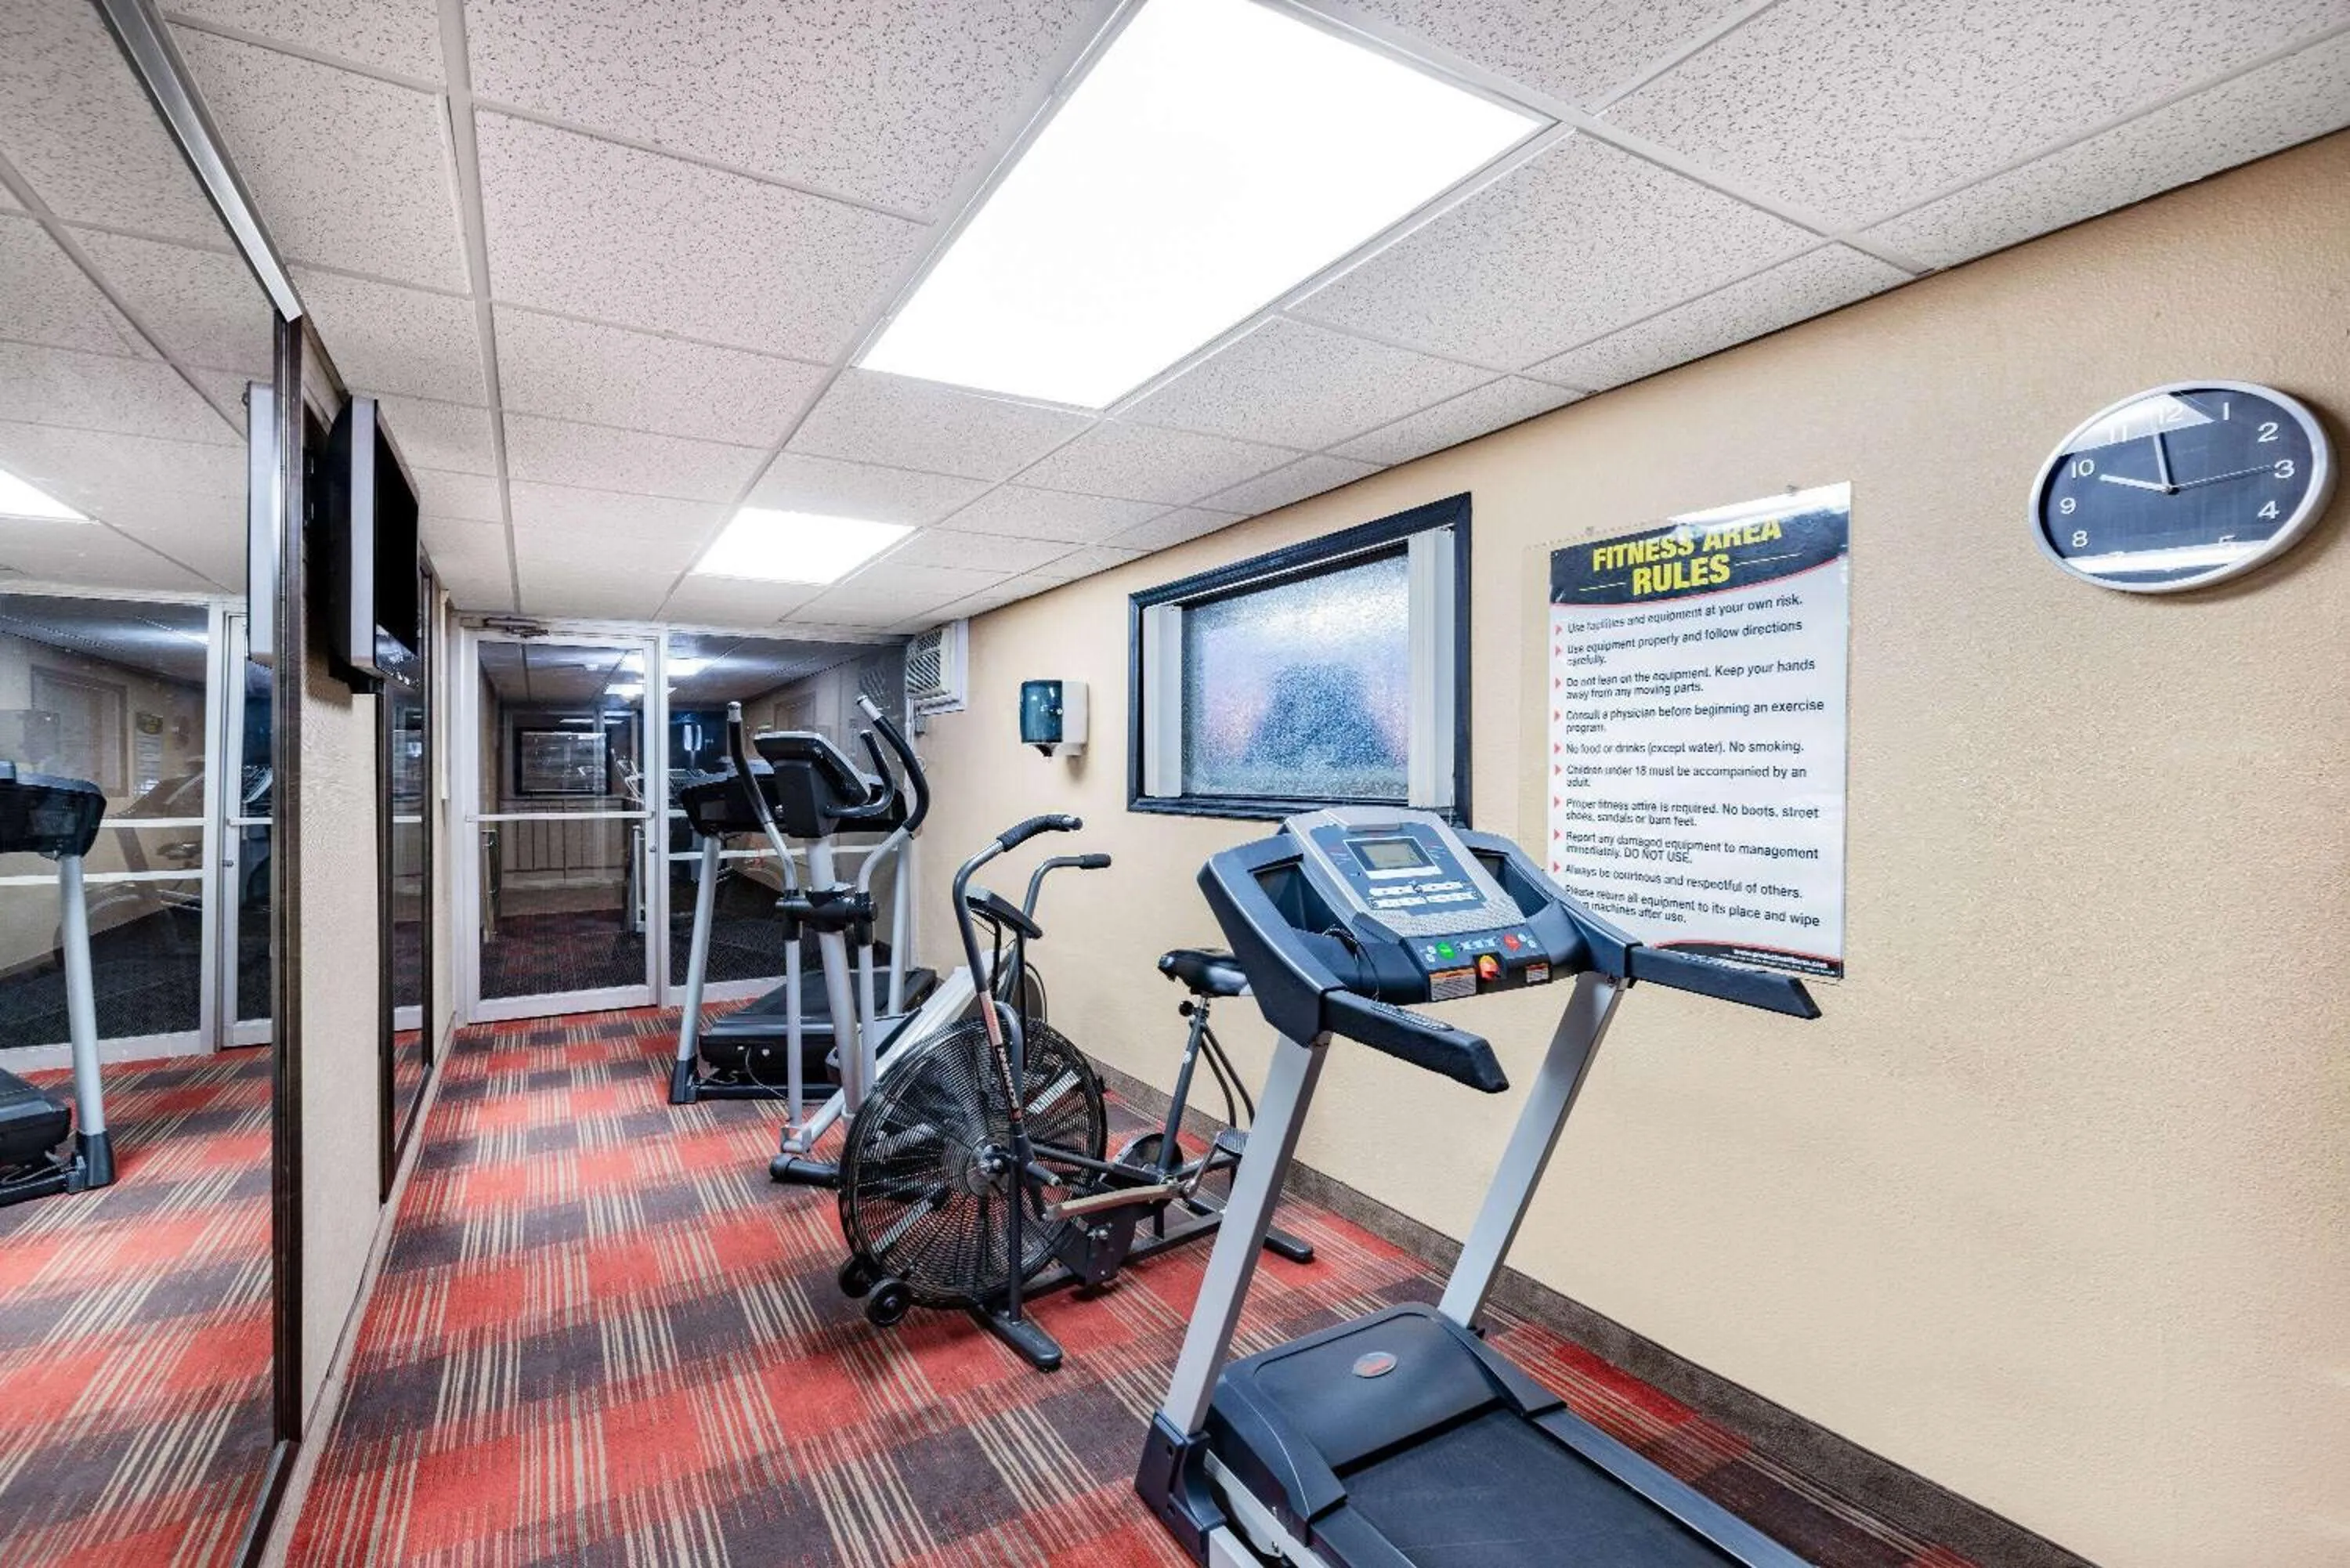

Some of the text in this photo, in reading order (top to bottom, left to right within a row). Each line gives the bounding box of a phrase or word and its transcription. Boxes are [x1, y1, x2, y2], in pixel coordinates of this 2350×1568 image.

[2159, 403, 2183, 424] 12
[2223, 402, 2229, 421] 1
[2258, 421, 2279, 443] 2
[2071, 459, 2095, 479] 10
[2274, 460, 2295, 479] 3
[2060, 497, 2076, 515] 9
[2258, 500, 2280, 519] 4
[1593, 517, 1783, 572] FITNESS AREA
[2072, 530, 2088, 547] 8
[1632, 553, 1730, 596] RULES
[1628, 614, 1645, 625] and
[1648, 609, 1702, 623] equipment
[1705, 606, 1716, 616] at
[1719, 603, 1744, 616] your
[1748, 599, 1773, 611] own
[1776, 594, 1802, 607] risk.
[1567, 621, 1802, 654] Use equipment properly and follow directions
[1567, 659, 1816, 687] Do not lean on the equipment. Keep your hands
[1567, 682, 1704, 701] away from any moving parts.
[1567, 699, 1824, 721] Consult a physician before beginning an exercise
[1567, 740, 1804, 757] No food or drinks (except water). No smoking.
[1567, 764, 1807, 779] Children under 18 must be accompanied by an
[1567, 777, 1590, 787] adult.
[1567, 797, 1819, 818] Proper fitness attire is required. No boots, street
[1597, 811, 1633, 823] sandals
[1635, 815, 1645, 823] or
[1649, 813, 1671, 825] bare
[1673, 815, 1697, 826] feet.
[1567, 831, 1819, 859] Report any damaged equipment to management
[1624, 847, 1640, 859] DO
[1642, 850, 1665, 861] NOT
[1667, 851, 1692, 863] USE.
[1566, 864, 1802, 898] Always be courteous and respectful of others.
[1566, 884, 1820, 928] Please return all equipment to its place and wipe
[1591, 901, 1636, 916] machines
[1638, 908, 1662, 919] after
[1665, 912, 1686, 924] use.
